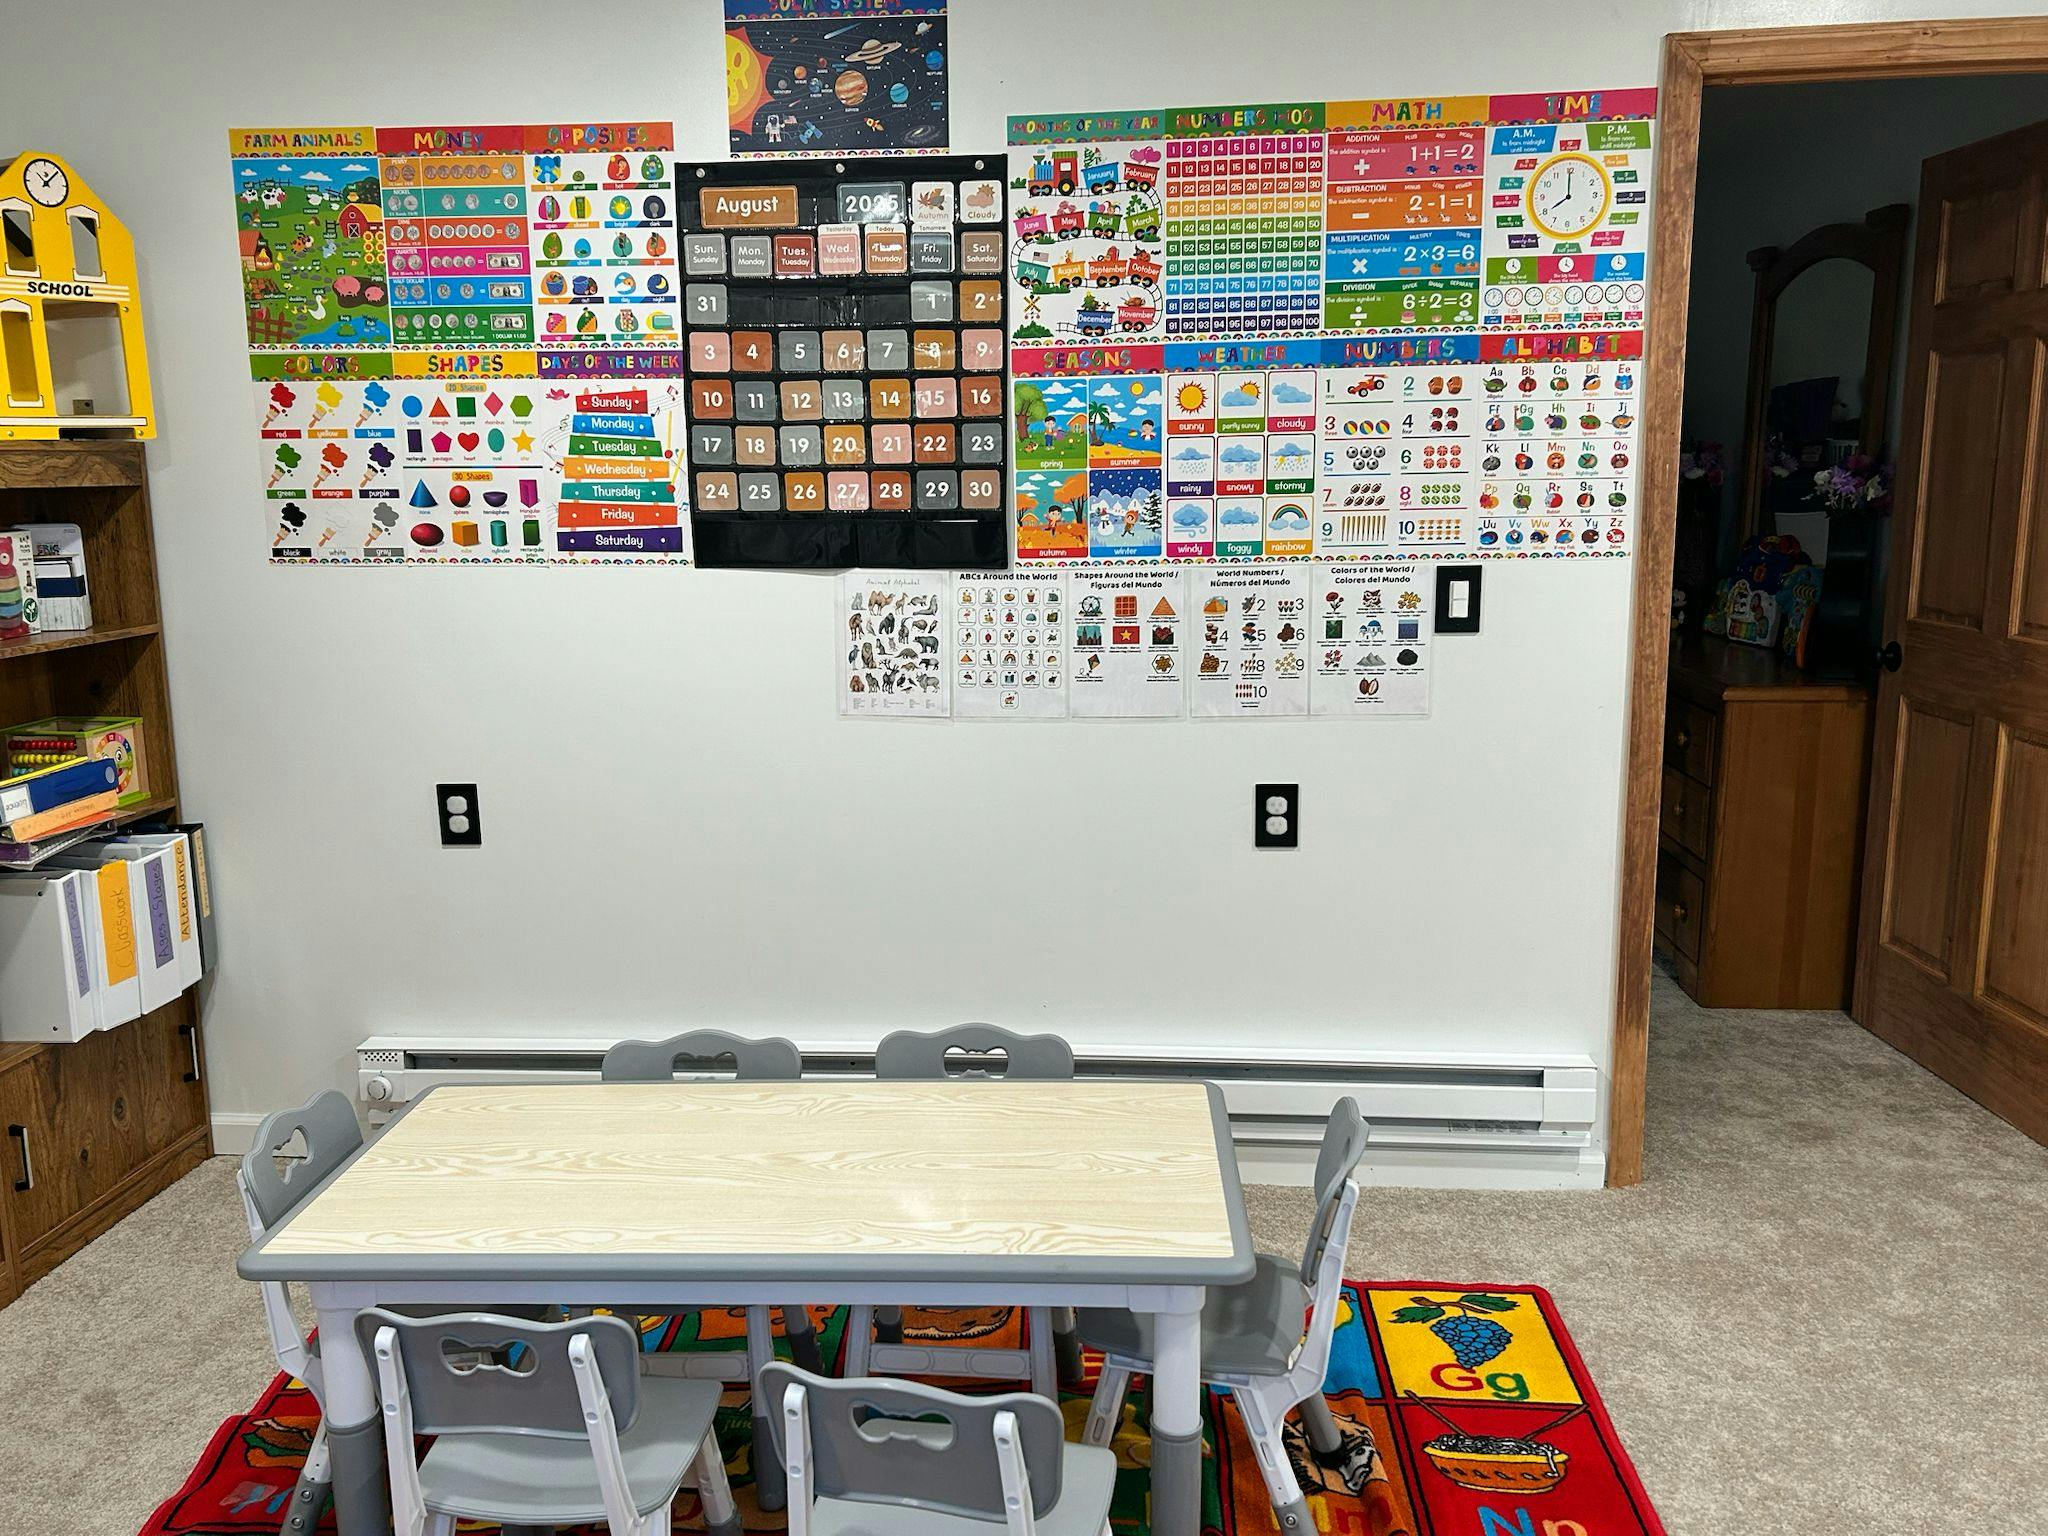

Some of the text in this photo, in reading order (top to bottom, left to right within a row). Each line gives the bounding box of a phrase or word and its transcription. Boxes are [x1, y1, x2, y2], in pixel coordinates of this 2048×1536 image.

[1372, 102, 1442, 121] MATH
[1176, 109, 1266, 129] NUMBERS
[1013, 116, 1158, 134] MONTHS OF THE YEAR
[1607, 124, 1630, 134] P.M.
[1346, 134, 1380, 142] ADDITION
[1512, 129, 1535, 138] A.M.
[244, 133, 363, 148] FARM ANIMALS
[414, 130, 484, 149] MONEY
[1312, 141, 1320, 149] 10
[1310, 160, 1321, 169] 20
[1087, 169, 1114, 183] January
[1125, 168, 1156, 181] February
[1336, 185, 1386, 193] SUBTRACTION
[716, 196, 778, 217] August
[967, 211, 996, 220] Cloudy
[1023, 220, 1039, 230] June
[1061, 217, 1077, 227] May
[1097, 216, 1113, 227] April
[1132, 216, 1154, 227] March
[1331, 234, 1390, 242] MULTIPLICATION
[694, 245, 716, 254] Sun.
[738, 247, 764, 255] Mon.
[782, 247, 809, 255] Tues.
[826, 244, 853, 253] Wed.
[973, 243, 992, 252] Sat.
[693, 255, 719, 264] Sunday
[738, 258, 765, 266] Monday
[781, 258, 809, 266] Tuesday
[823, 256, 855, 264] Wednesday
[871, 255, 902, 263] Thursday
[921, 255, 942, 264] Friday
[967, 254, 997, 263] Saturday
[1025, 267, 1038, 278] July
[1057, 266, 1081, 278] August
[1089, 265, 1127, 276] September
[1132, 263, 1159, 276] October
[27, 282, 93, 297] SCHOOL
[1343, 283, 1376, 291] DIVISION
[697, 296, 716, 312] 31
[975, 293, 986, 309] 2
[1078, 314, 1112, 325] December
[1119, 310, 1154, 319] November
[1345, 338, 1454, 359] NUMBERS
[1502, 335, 1620, 356] ALPHABET
[795, 344, 805, 359] 5
[1198, 346, 1286, 363] WEATHER
[284, 355, 360, 374] COLORS
[428, 355, 504, 372] SHAPES
[541, 354, 678, 369] DAYS OF THE WEEK
[1043, 351, 1132, 368] SEASONS
[1522, 366, 1534, 375] Bb
[1404, 376, 1414, 391] 2
[591, 397, 631, 408] Sunday
[702, 392, 723, 407] 10
[592, 418, 634, 430] Monday
[1277, 419, 1306, 428] cloudy
[1402, 414, 1413, 428] 4
[1179, 423, 1204, 431] sunny
[317, 430, 338, 438] yellow
[592, 441, 636, 453] Tuesday
[702, 437, 721, 452] 17
[832, 437, 856, 452] 20
[971, 435, 994, 451] 23
[1486, 444, 1499, 453] Kk
[1040, 460, 1063, 468] spring
[1324, 452, 1334, 465] 5
[585, 462, 646, 475] Wednesday
[593, 486, 640, 498] Thursday
[705, 484, 729, 499] 24
[969, 481, 992, 496] 30
[1180, 484, 1201, 493] rainy
[1226, 483, 1254, 492] snowy
[1275, 482, 1306, 491] stormy
[277, 490, 296, 498] green
[369, 490, 389, 498] purple
[748, 485, 771, 500] 25
[1400, 486, 1410, 500] 8
[602, 509, 634, 521] Friday
[1610, 519, 1622, 527] Zz
[596, 534, 643, 547] Saturday
[1177, 545, 1202, 554] windy
[1227, 543, 1251, 554] foggy
[1272, 543, 1306, 551] rainbow
[1210, 579, 1246, 587] Números
[176, 845, 189, 936] Attendance
[112, 887, 133, 968] Classwork
[158, 924, 171, 958] Ages
